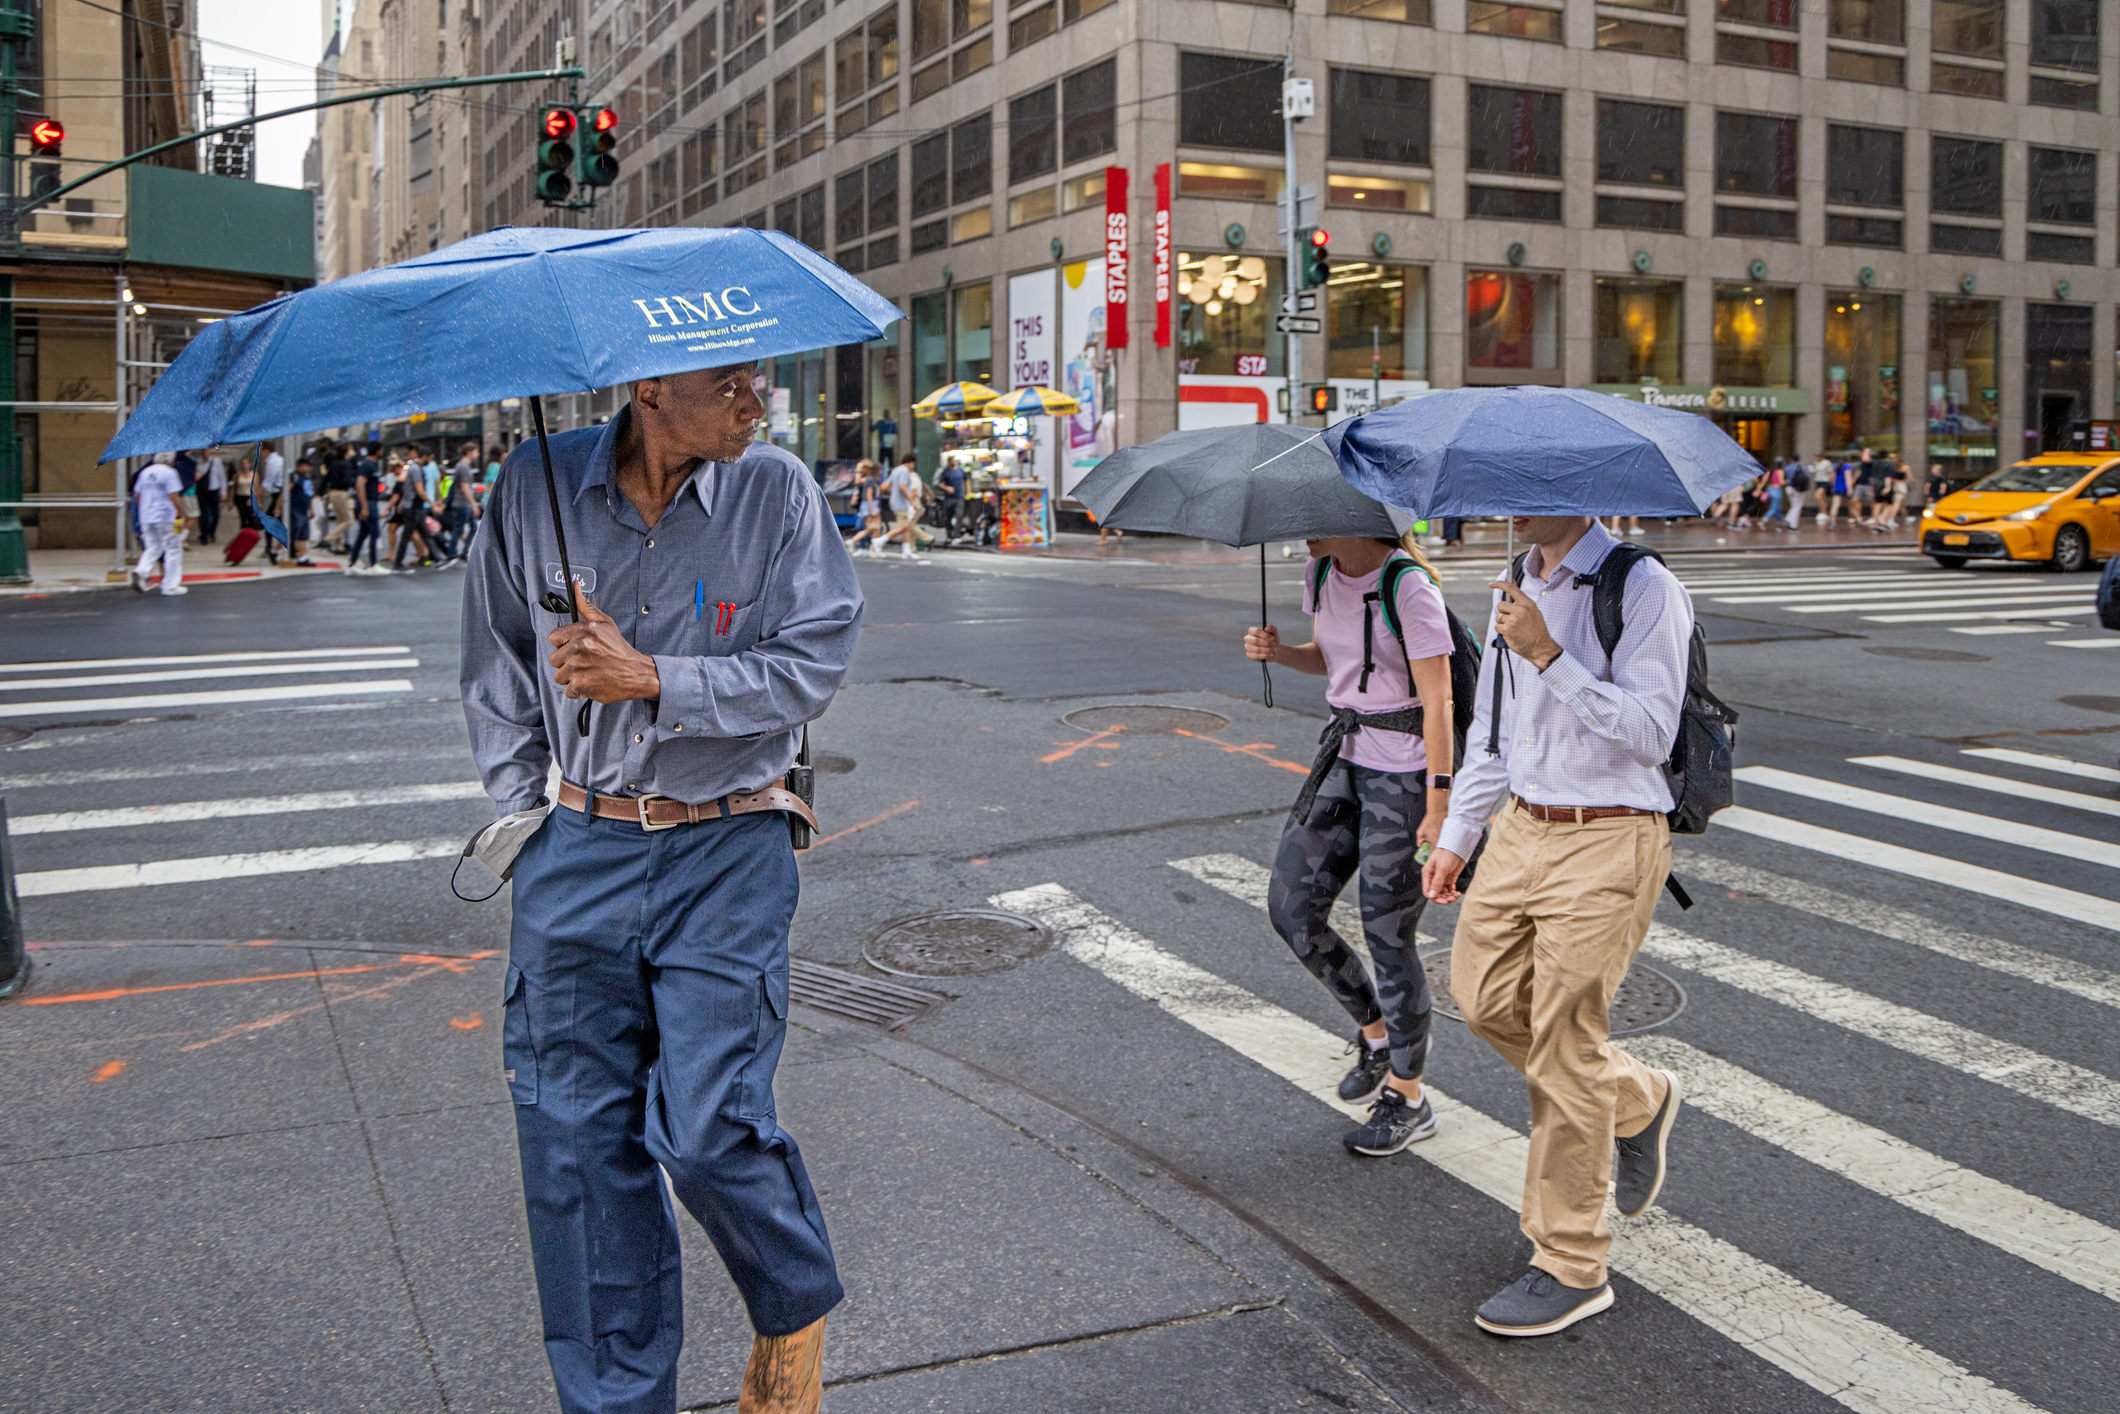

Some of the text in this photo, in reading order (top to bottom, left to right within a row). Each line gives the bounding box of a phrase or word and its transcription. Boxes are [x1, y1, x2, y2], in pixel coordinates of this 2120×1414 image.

[1107, 212, 1127, 304] STAPLES
[1155, 209, 1169, 302] STAPLES
[632, 285, 762, 328] HMC
[648, 317, 779, 343] Hilson Management Corporation
[1014, 315, 1042, 338] THIS
[687, 337, 755, 352] www.HilsonMgt.com
[1016, 340, 1027, 360] IS
[1014, 360, 1049, 382] YOUR
[1344, 388, 1369, 400] THE
[1640, 386, 1706, 407] Panera
[555, 570, 586, 587] Cutis
